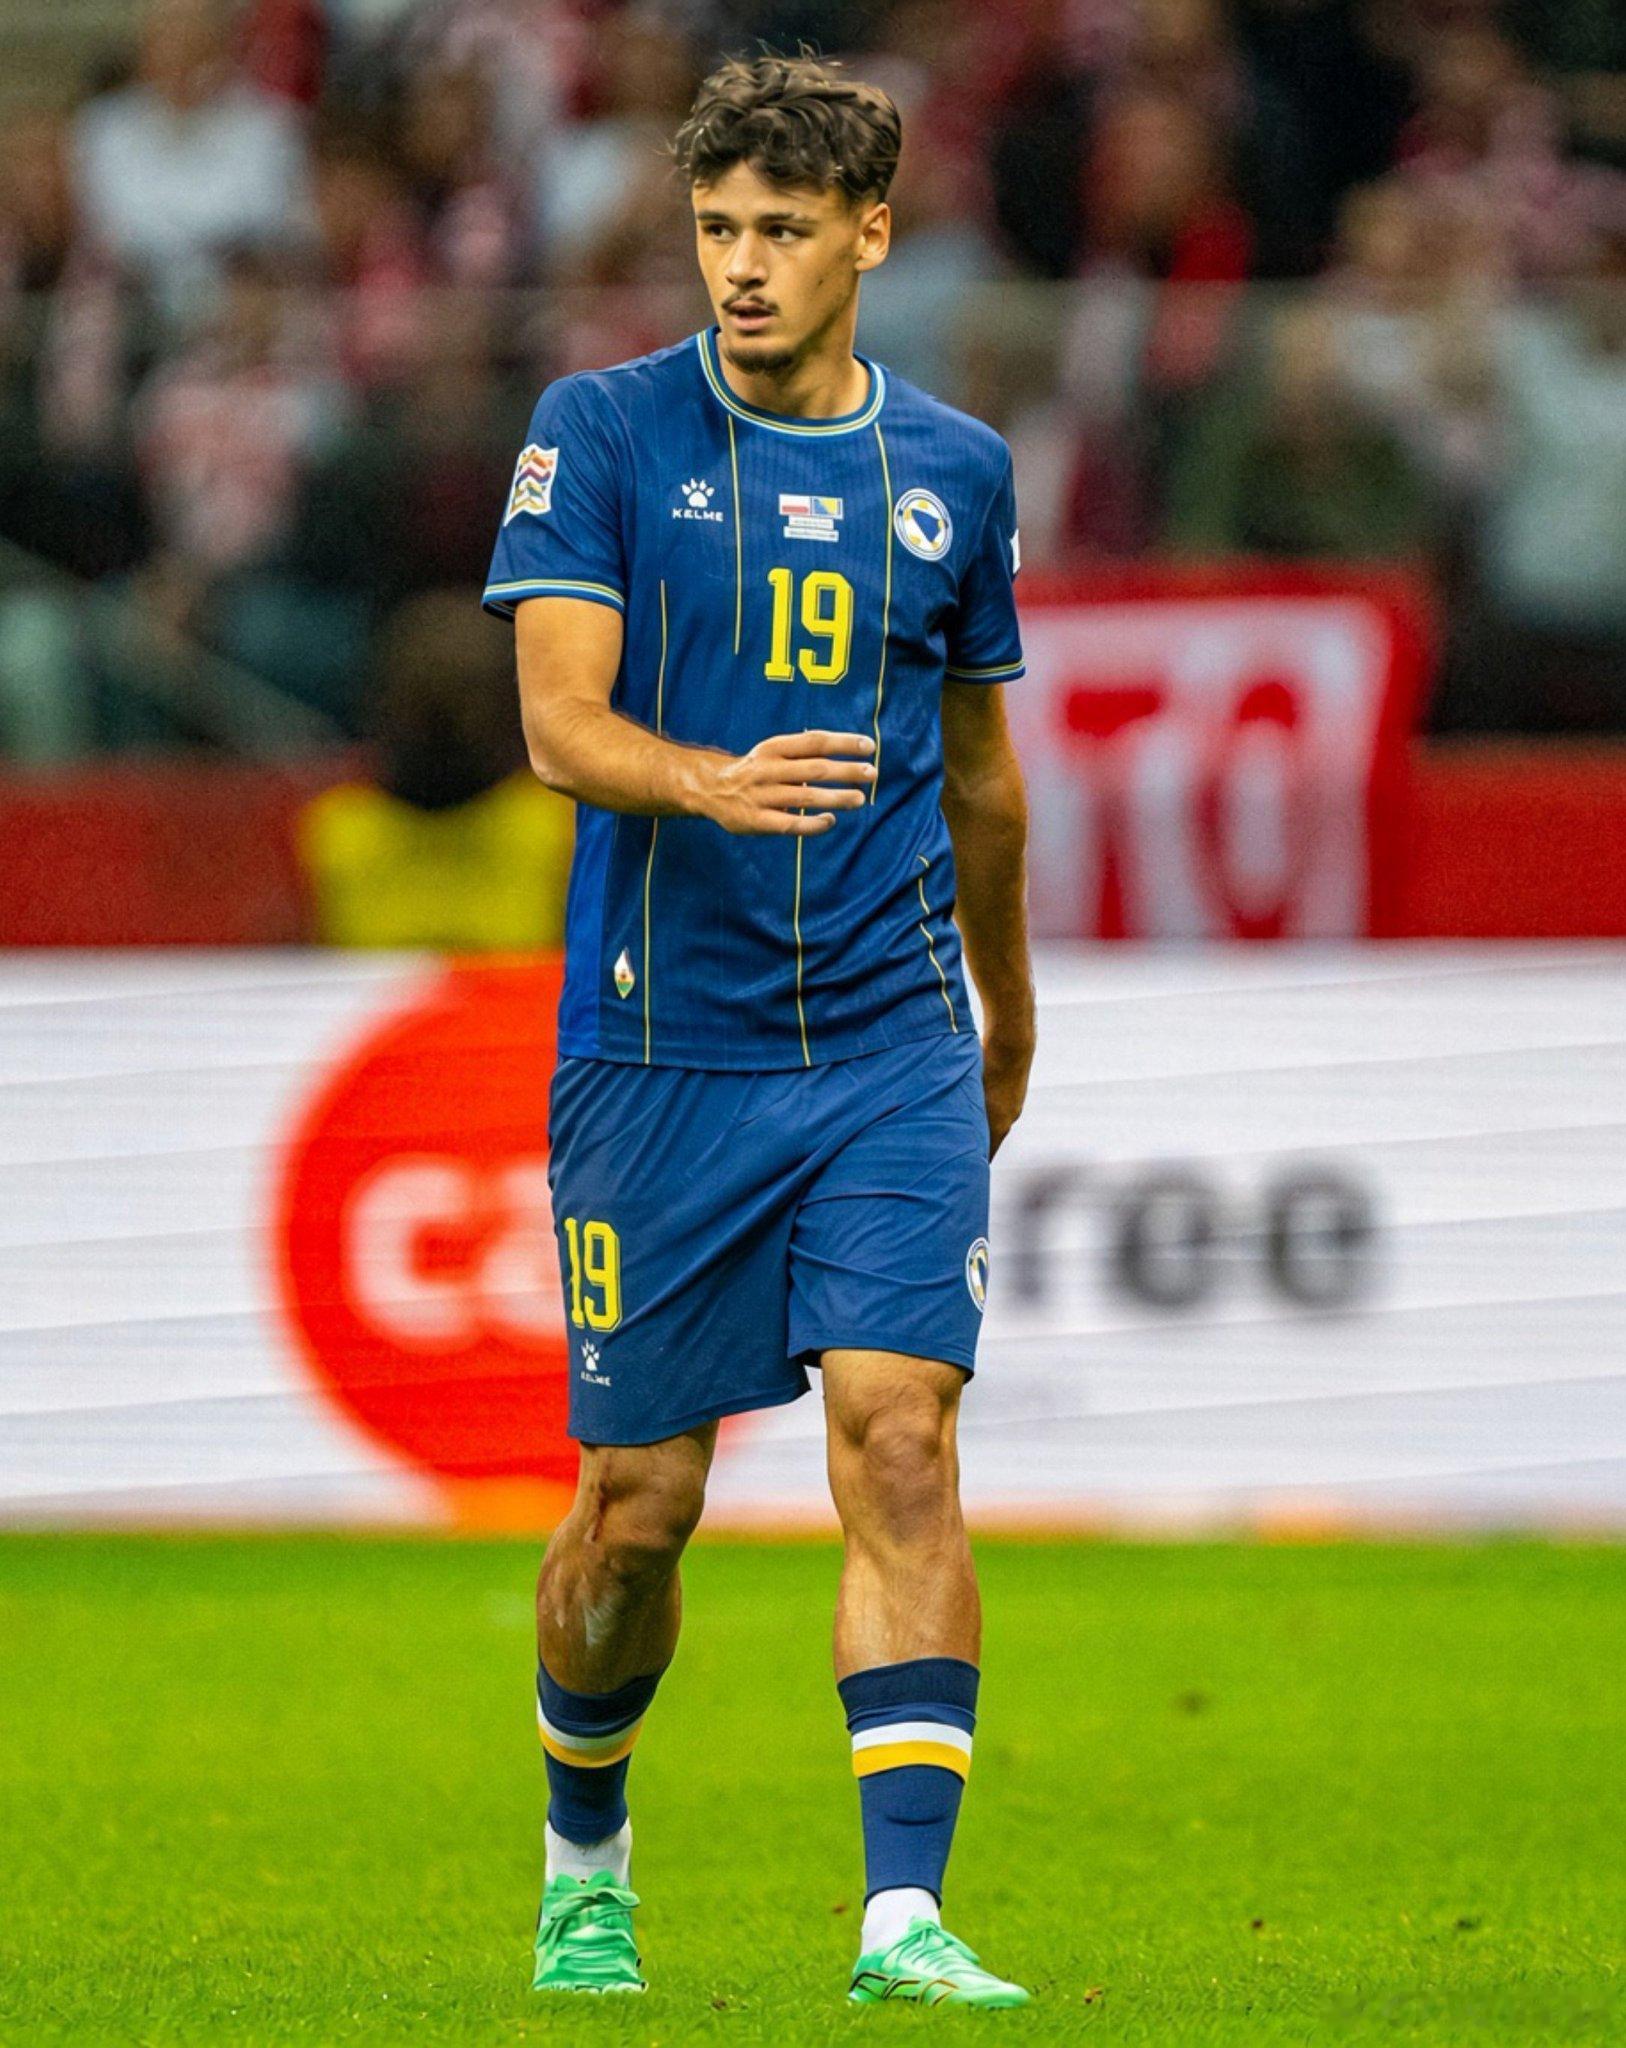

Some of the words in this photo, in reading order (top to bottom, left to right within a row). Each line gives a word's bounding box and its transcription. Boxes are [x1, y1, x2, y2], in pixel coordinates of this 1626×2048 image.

[672, 507, 724, 521] KELME
[764, 567, 854, 685] 19
[564, 1217, 622, 1332] 19
[1008, 1156, 1380, 1318] ree
